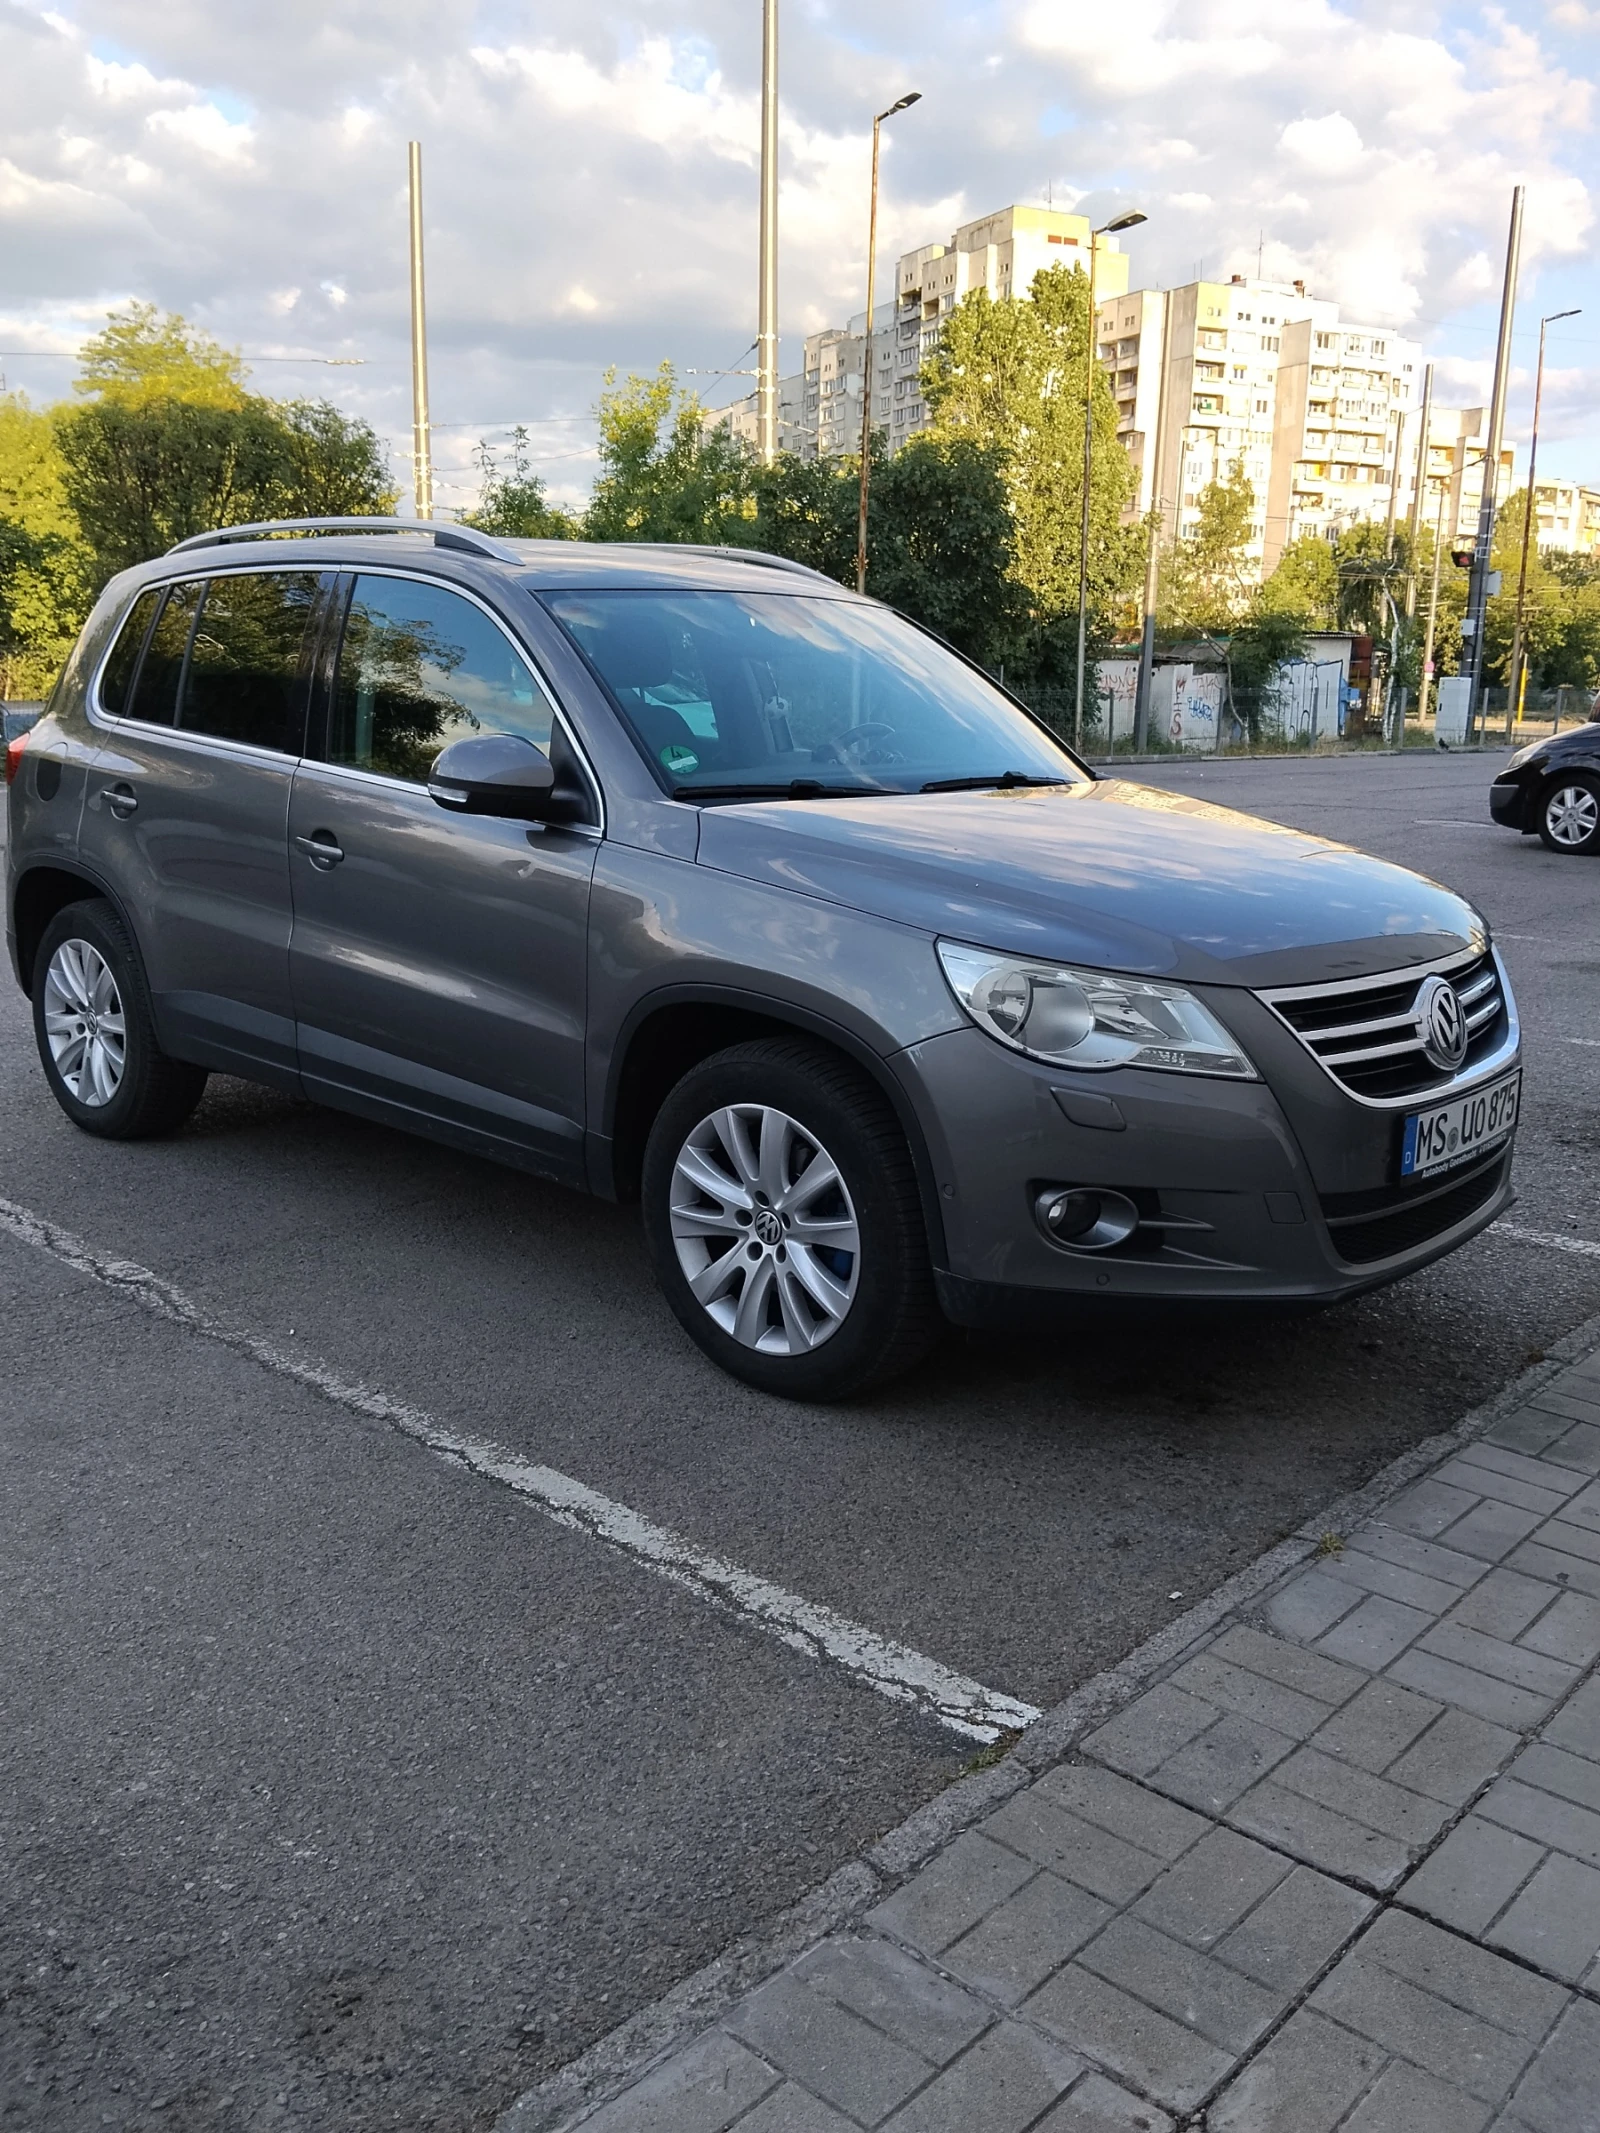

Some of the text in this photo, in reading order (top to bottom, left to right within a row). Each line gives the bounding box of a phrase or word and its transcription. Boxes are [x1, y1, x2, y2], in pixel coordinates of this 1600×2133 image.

[670, 746, 683, 759] 4
[1404, 1151, 1411, 1165] D
[1415, 1112, 1448, 1164] MS
[1461, 1097, 1486, 1145] UO
[1488, 1077, 1517, 1132] 875
